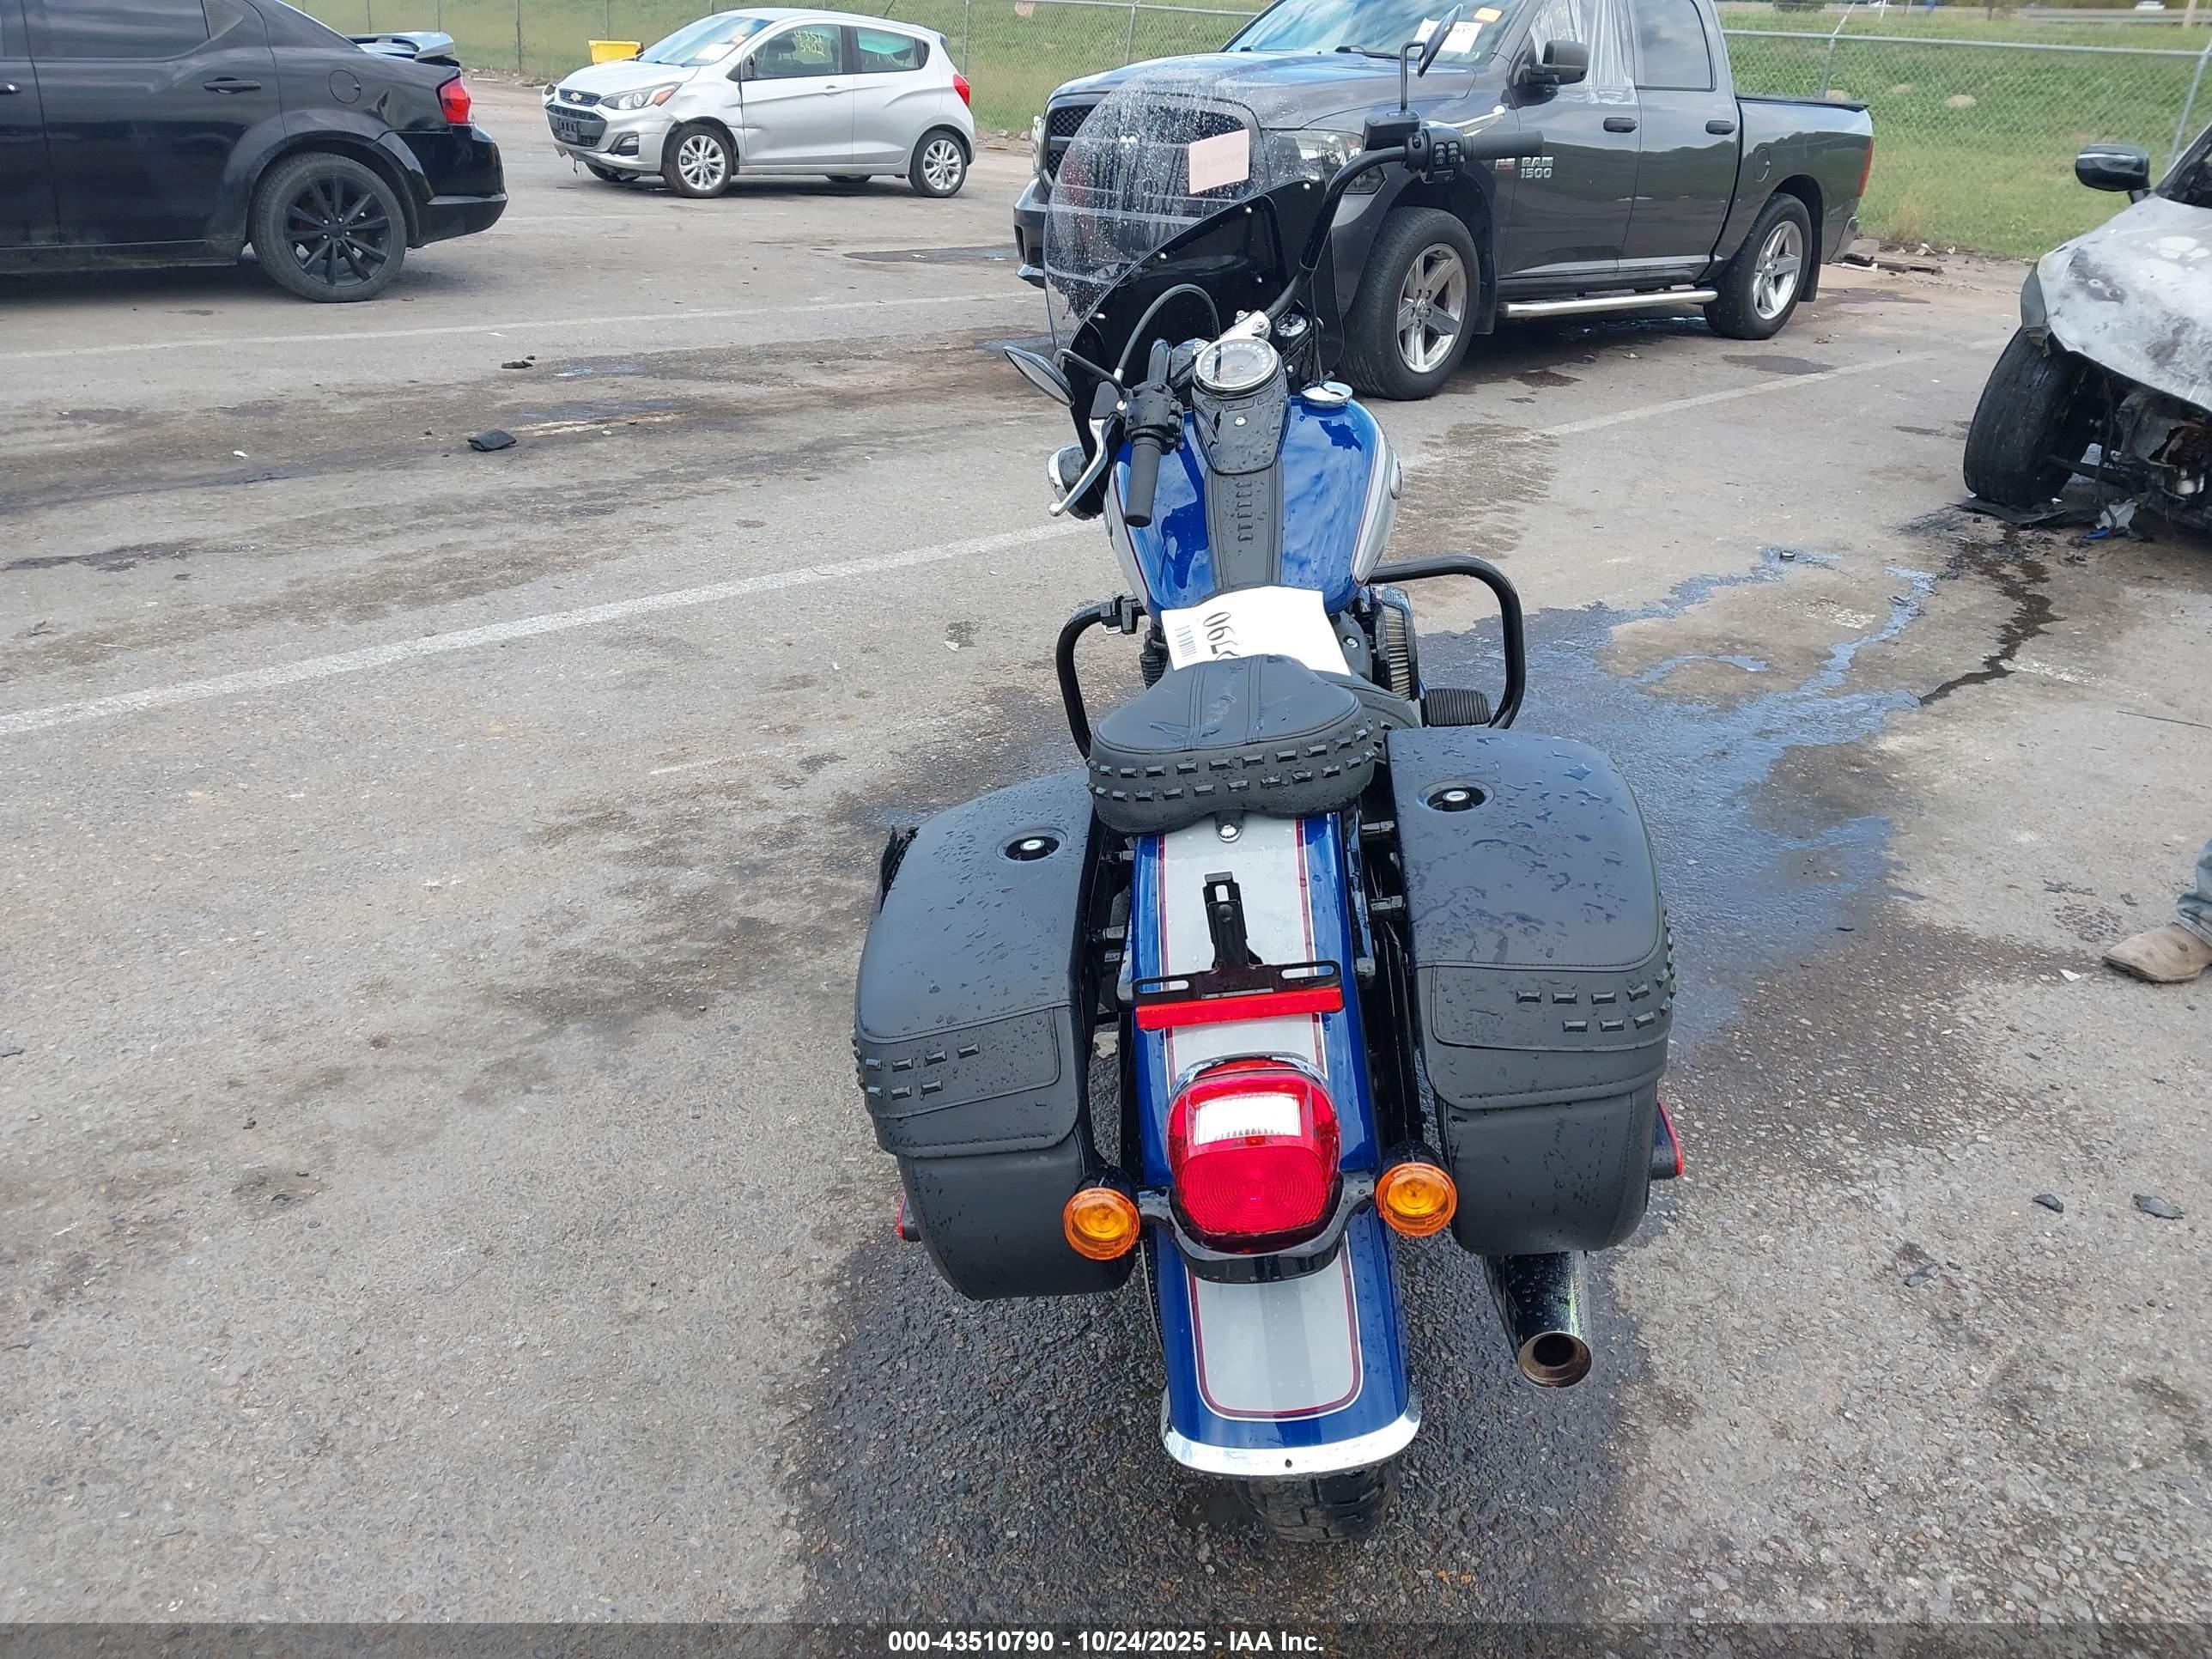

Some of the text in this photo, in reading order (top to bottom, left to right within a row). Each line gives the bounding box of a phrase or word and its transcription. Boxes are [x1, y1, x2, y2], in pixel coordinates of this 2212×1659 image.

[793, 29, 822, 44] 4351
[799, 42, 826, 57] 5902
[1521, 156, 1554, 167] RAM
[1520, 167, 1553, 179] 1500
